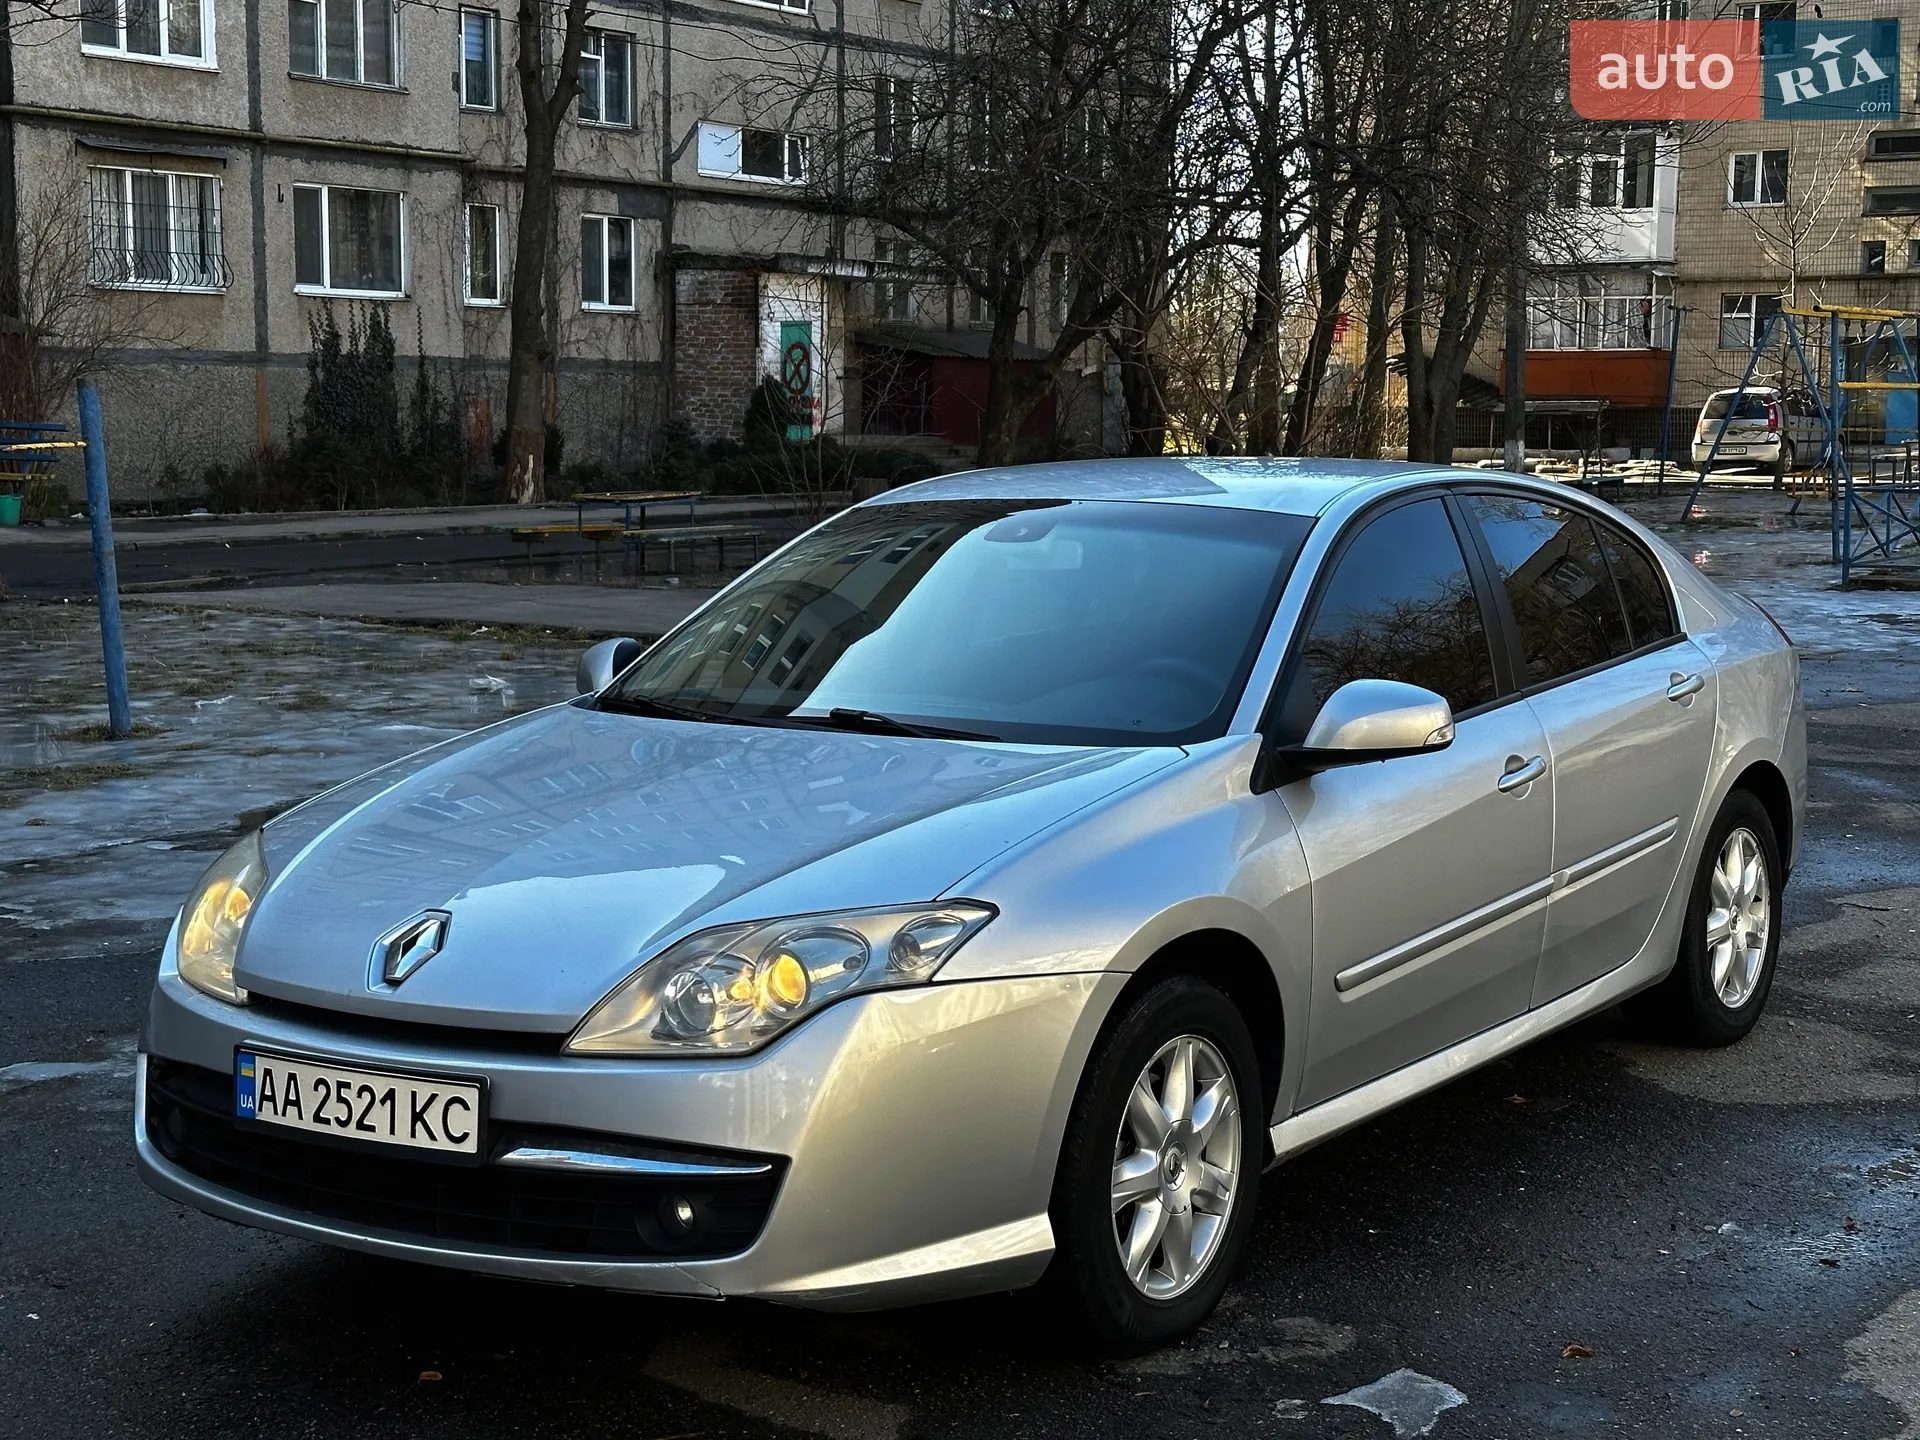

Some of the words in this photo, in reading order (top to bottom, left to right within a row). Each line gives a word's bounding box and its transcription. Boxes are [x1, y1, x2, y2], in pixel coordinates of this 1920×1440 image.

[240, 1093, 254, 1109] UA
[257, 1067, 304, 1120] AA
[312, 1077, 397, 1136] 2521
[410, 1089, 471, 1145] KC
